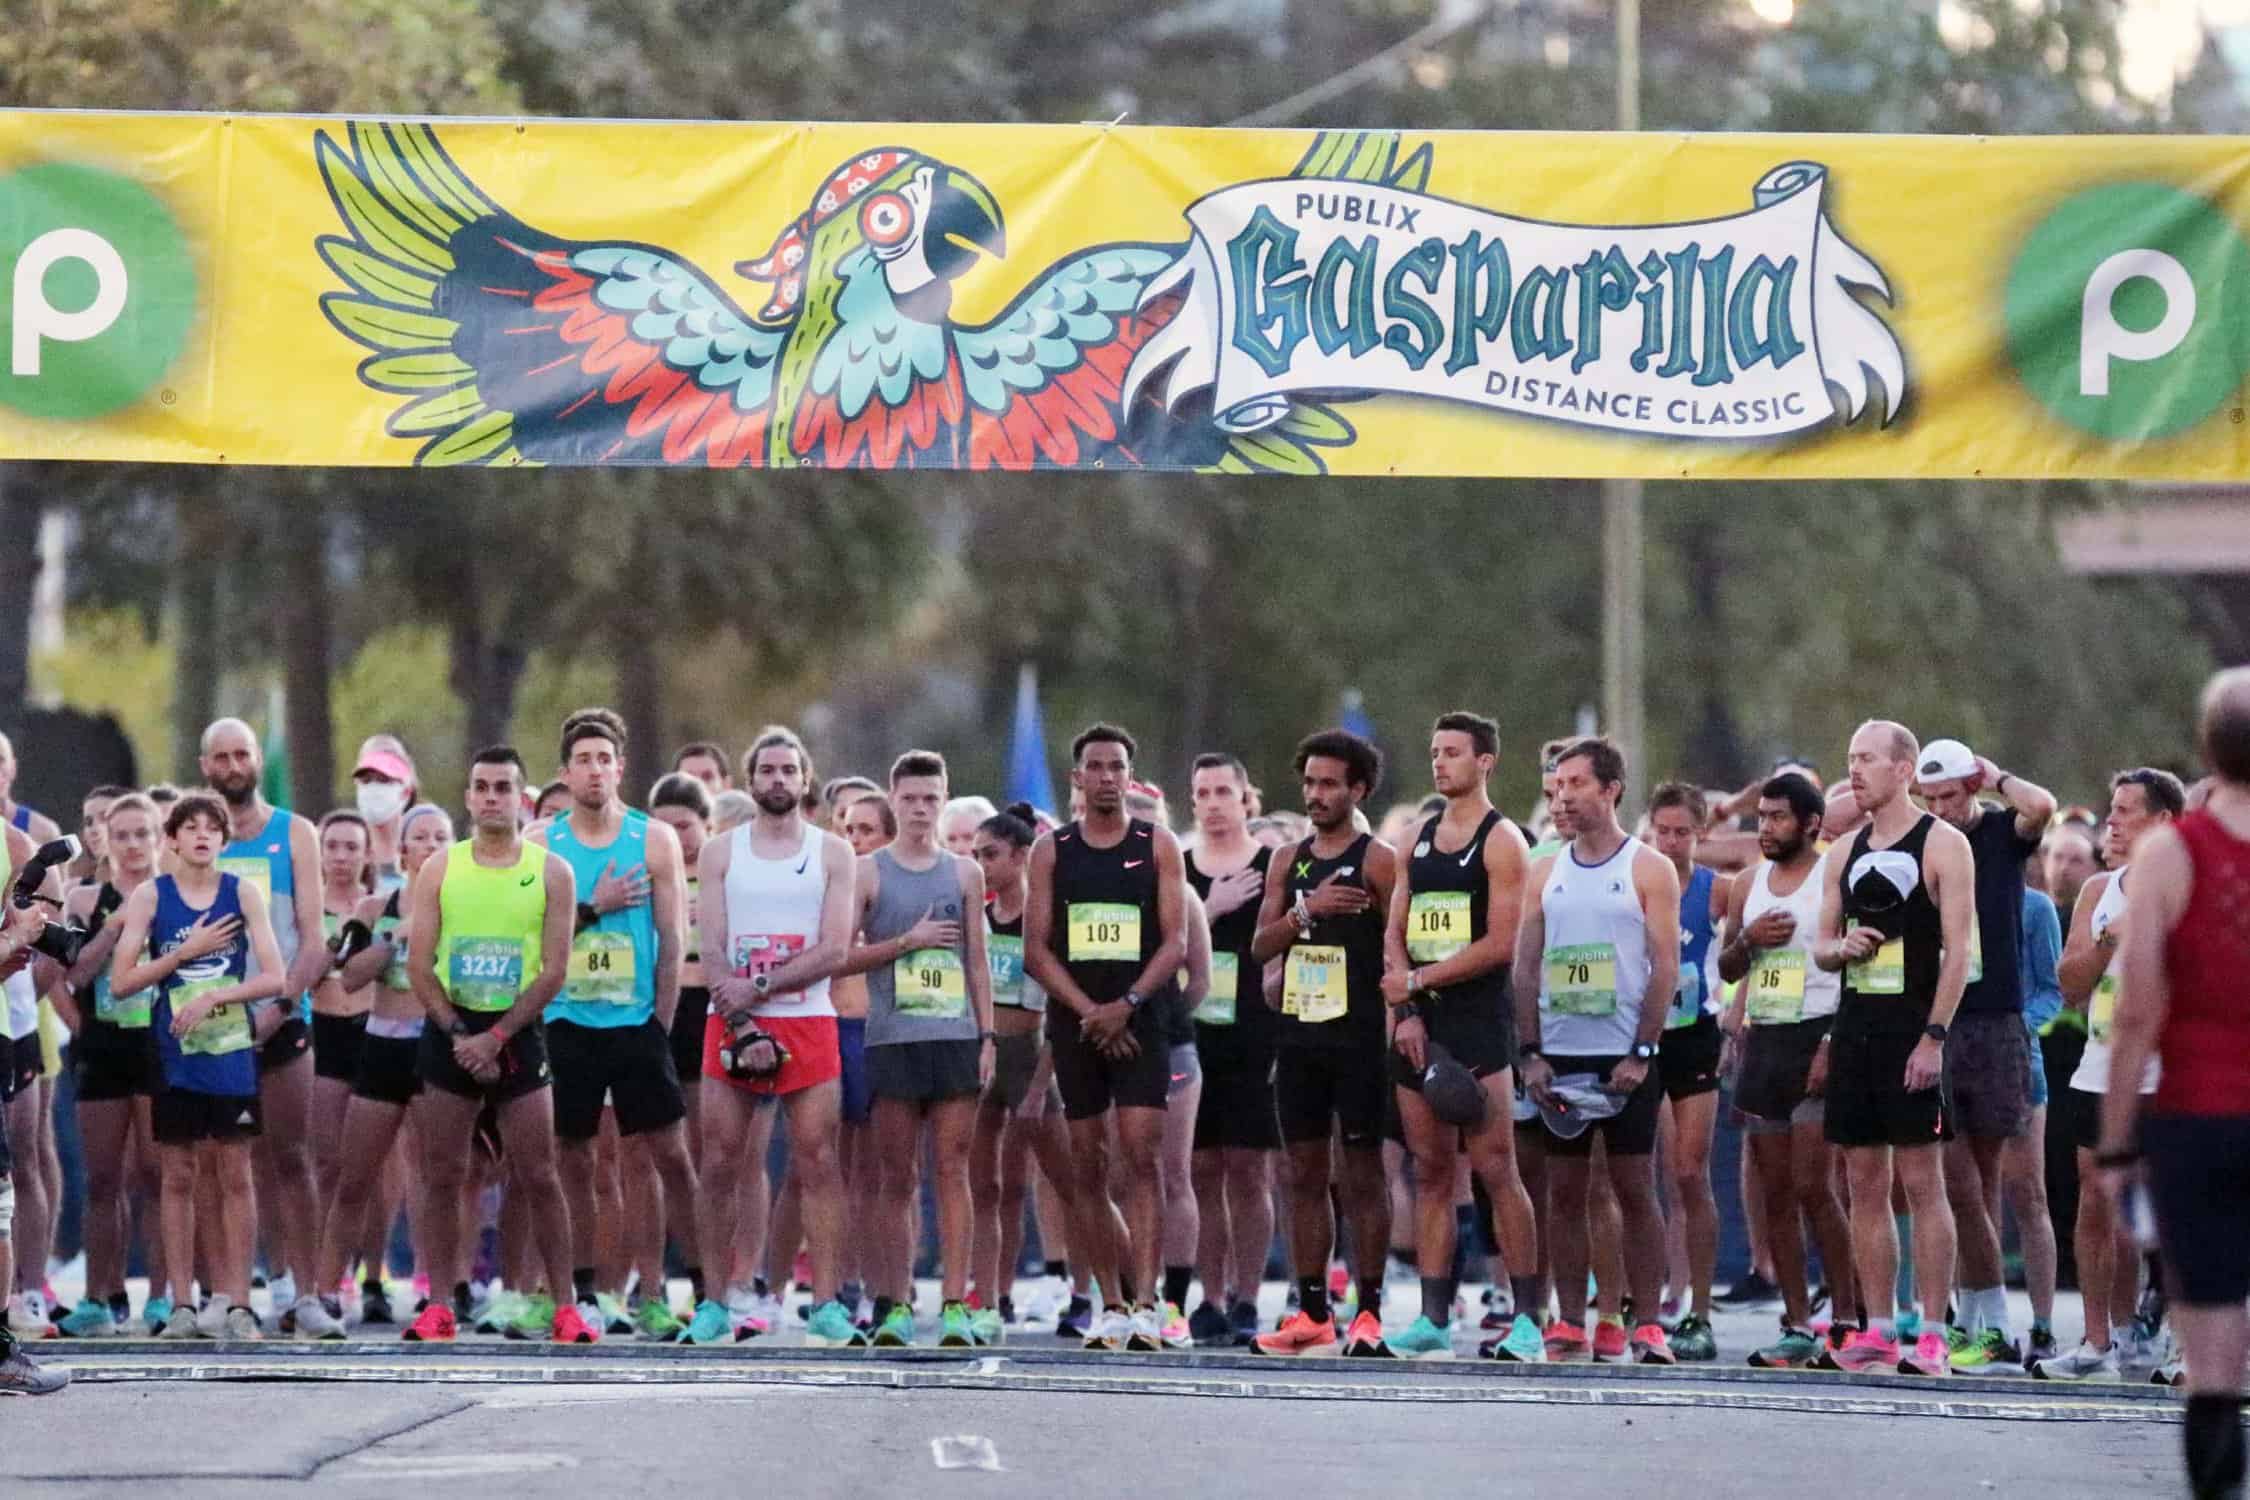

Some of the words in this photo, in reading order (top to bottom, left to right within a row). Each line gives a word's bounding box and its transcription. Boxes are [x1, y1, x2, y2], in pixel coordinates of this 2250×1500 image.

[1295, 192, 1421, 234] PUBLIX
[1227, 204, 1806, 387] Gasparilla
[1486, 371, 1652, 420] DISTANCE
[1667, 391, 1806, 426] CLASSIC
[1421, 911, 1452, 931] 104
[1087, 923, 1120, 942] 103
[461, 954, 511, 976] 3237
[588, 952, 610, 972] 84
[921, 969, 942, 988] 90
[1567, 964, 1589, 984] 70
[1760, 969, 1780, 988] 36
